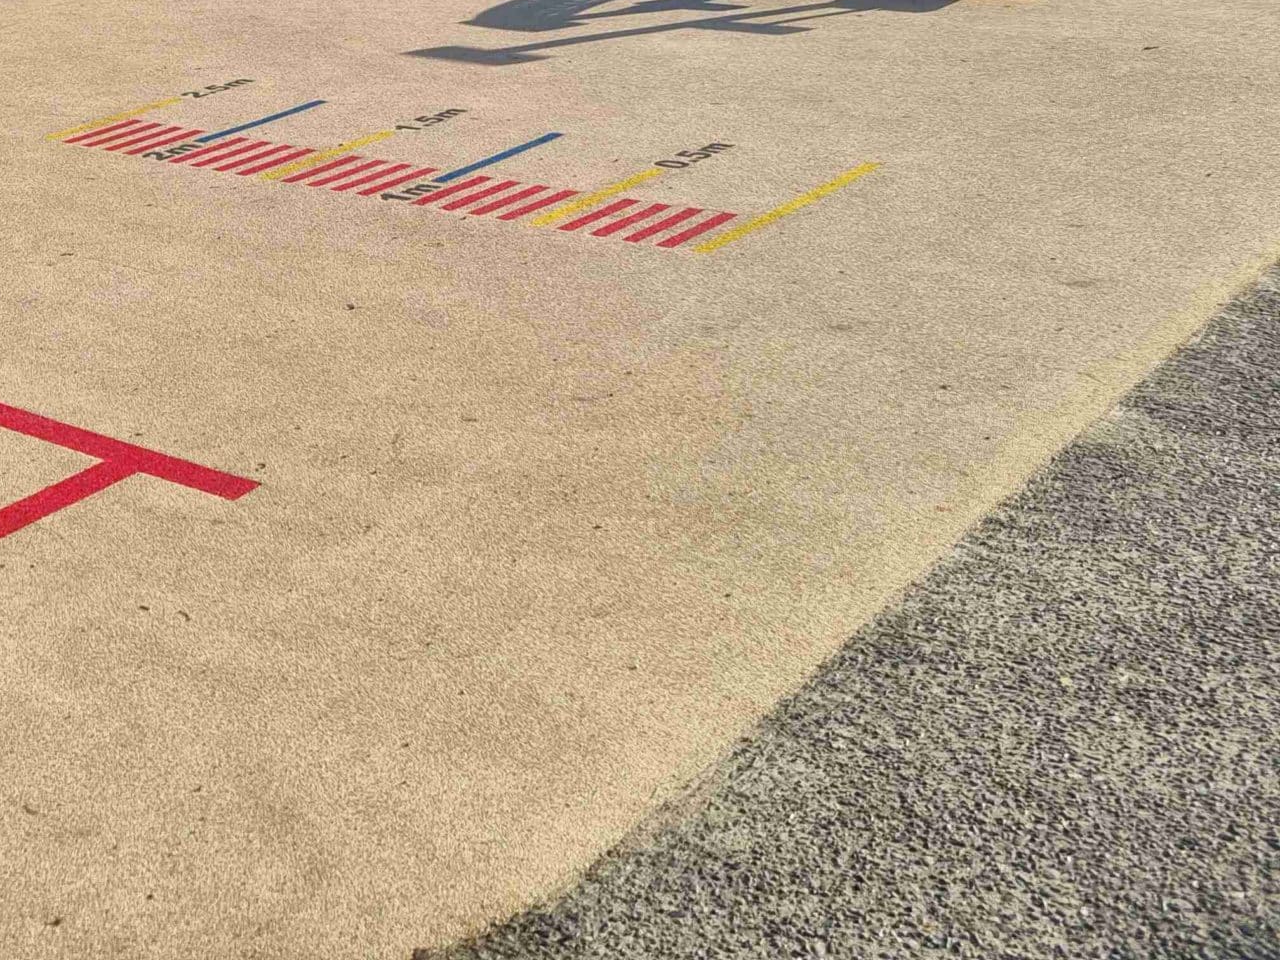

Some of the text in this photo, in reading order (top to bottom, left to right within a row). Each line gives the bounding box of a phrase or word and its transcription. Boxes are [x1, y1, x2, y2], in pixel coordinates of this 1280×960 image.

[181, 79, 256, 98] 2.5m
[395, 108, 468, 130] 1.5m
[142, 144, 202, 160] 2m
[654, 143, 736, 168] 0.5m
[380, 184, 442, 200] 1m
